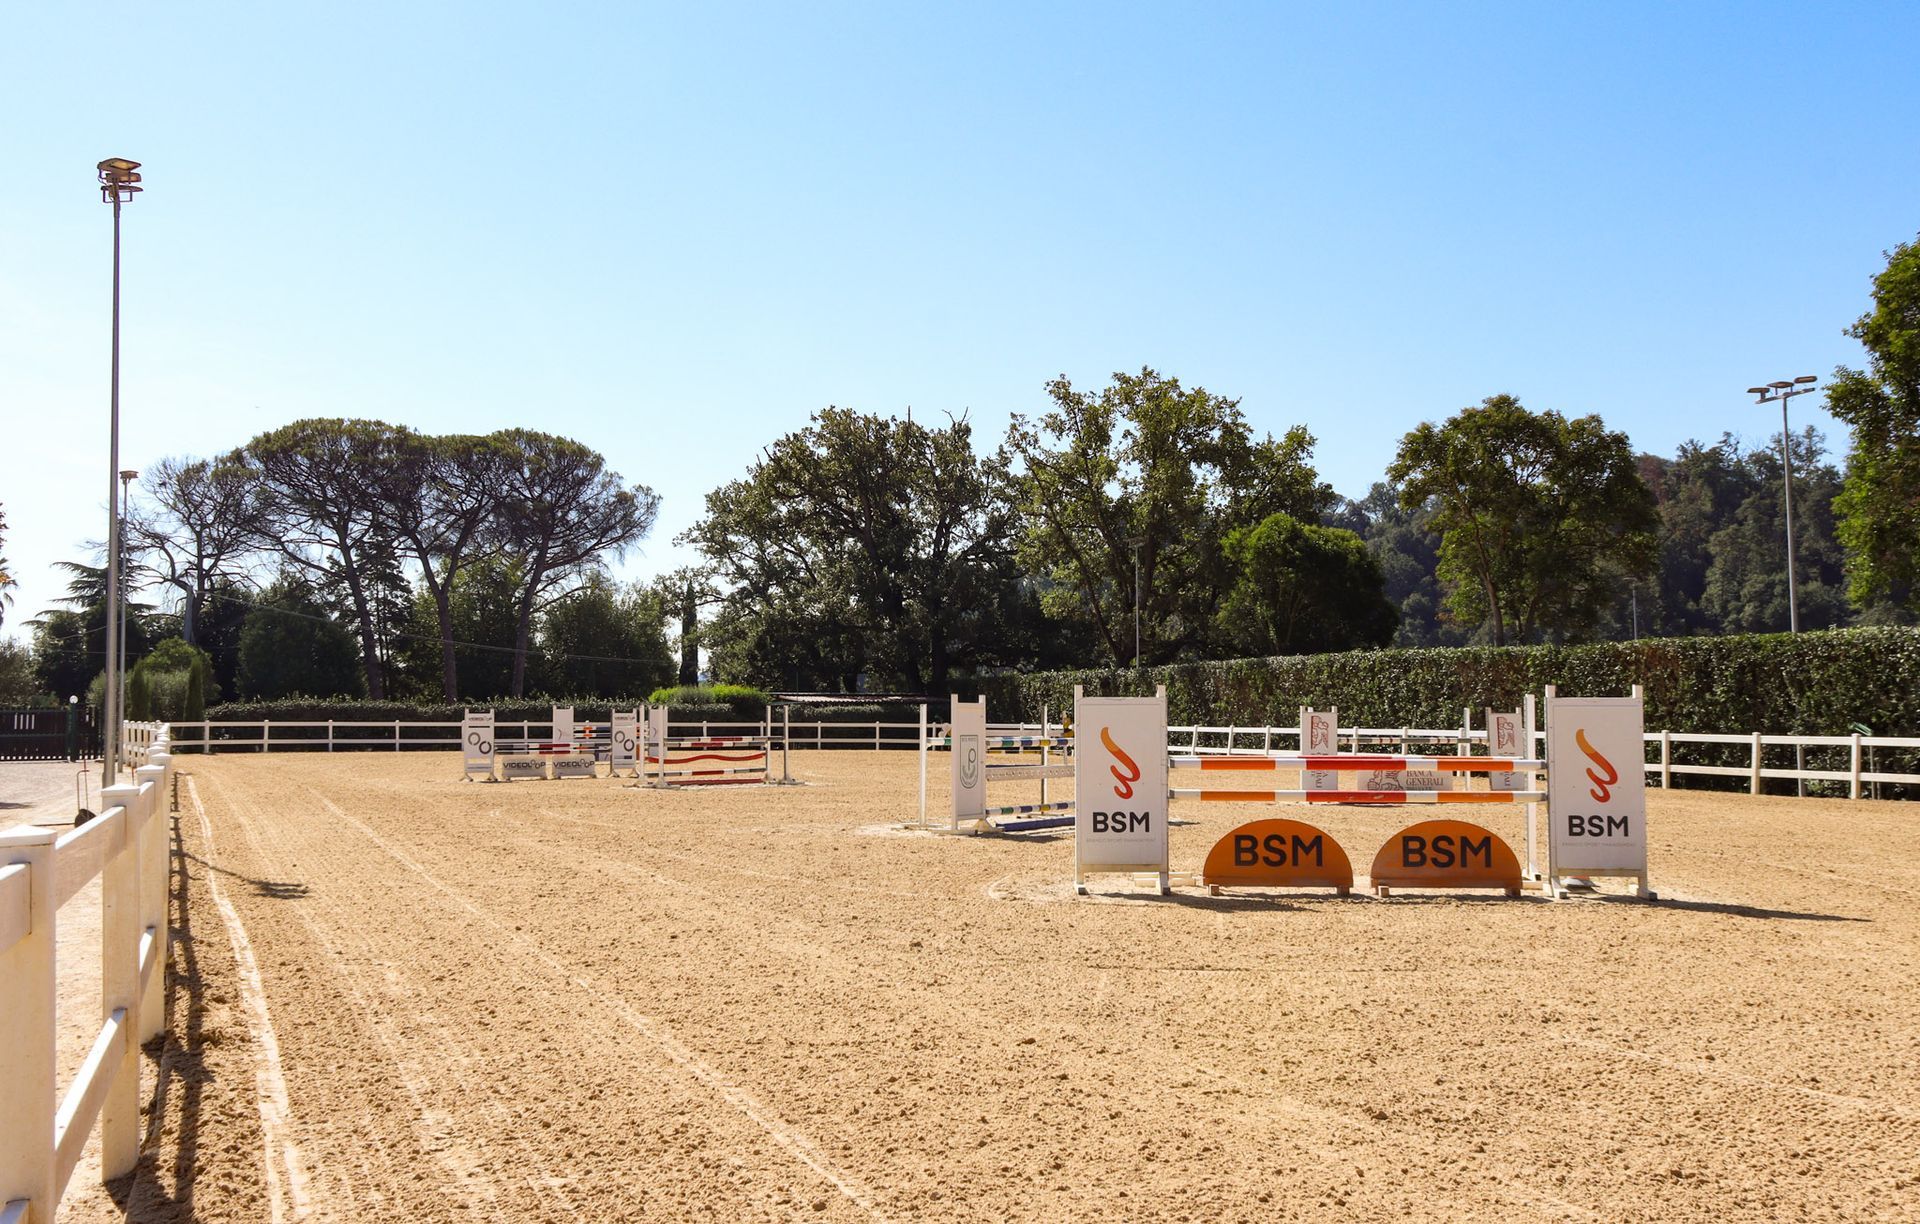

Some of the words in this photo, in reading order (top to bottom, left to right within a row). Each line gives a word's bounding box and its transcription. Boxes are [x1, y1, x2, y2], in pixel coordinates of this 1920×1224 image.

[503, 759, 546, 769] VIDEOLOOP
[553, 758, 594, 768] VIDEOLOOP
[1406, 777, 1444, 786] GENERALI
[1092, 811, 1150, 833] BSM
[1568, 815, 1629, 837] BSM
[1234, 834, 1323, 867] BSM
[1402, 835, 1493, 868] BSM
